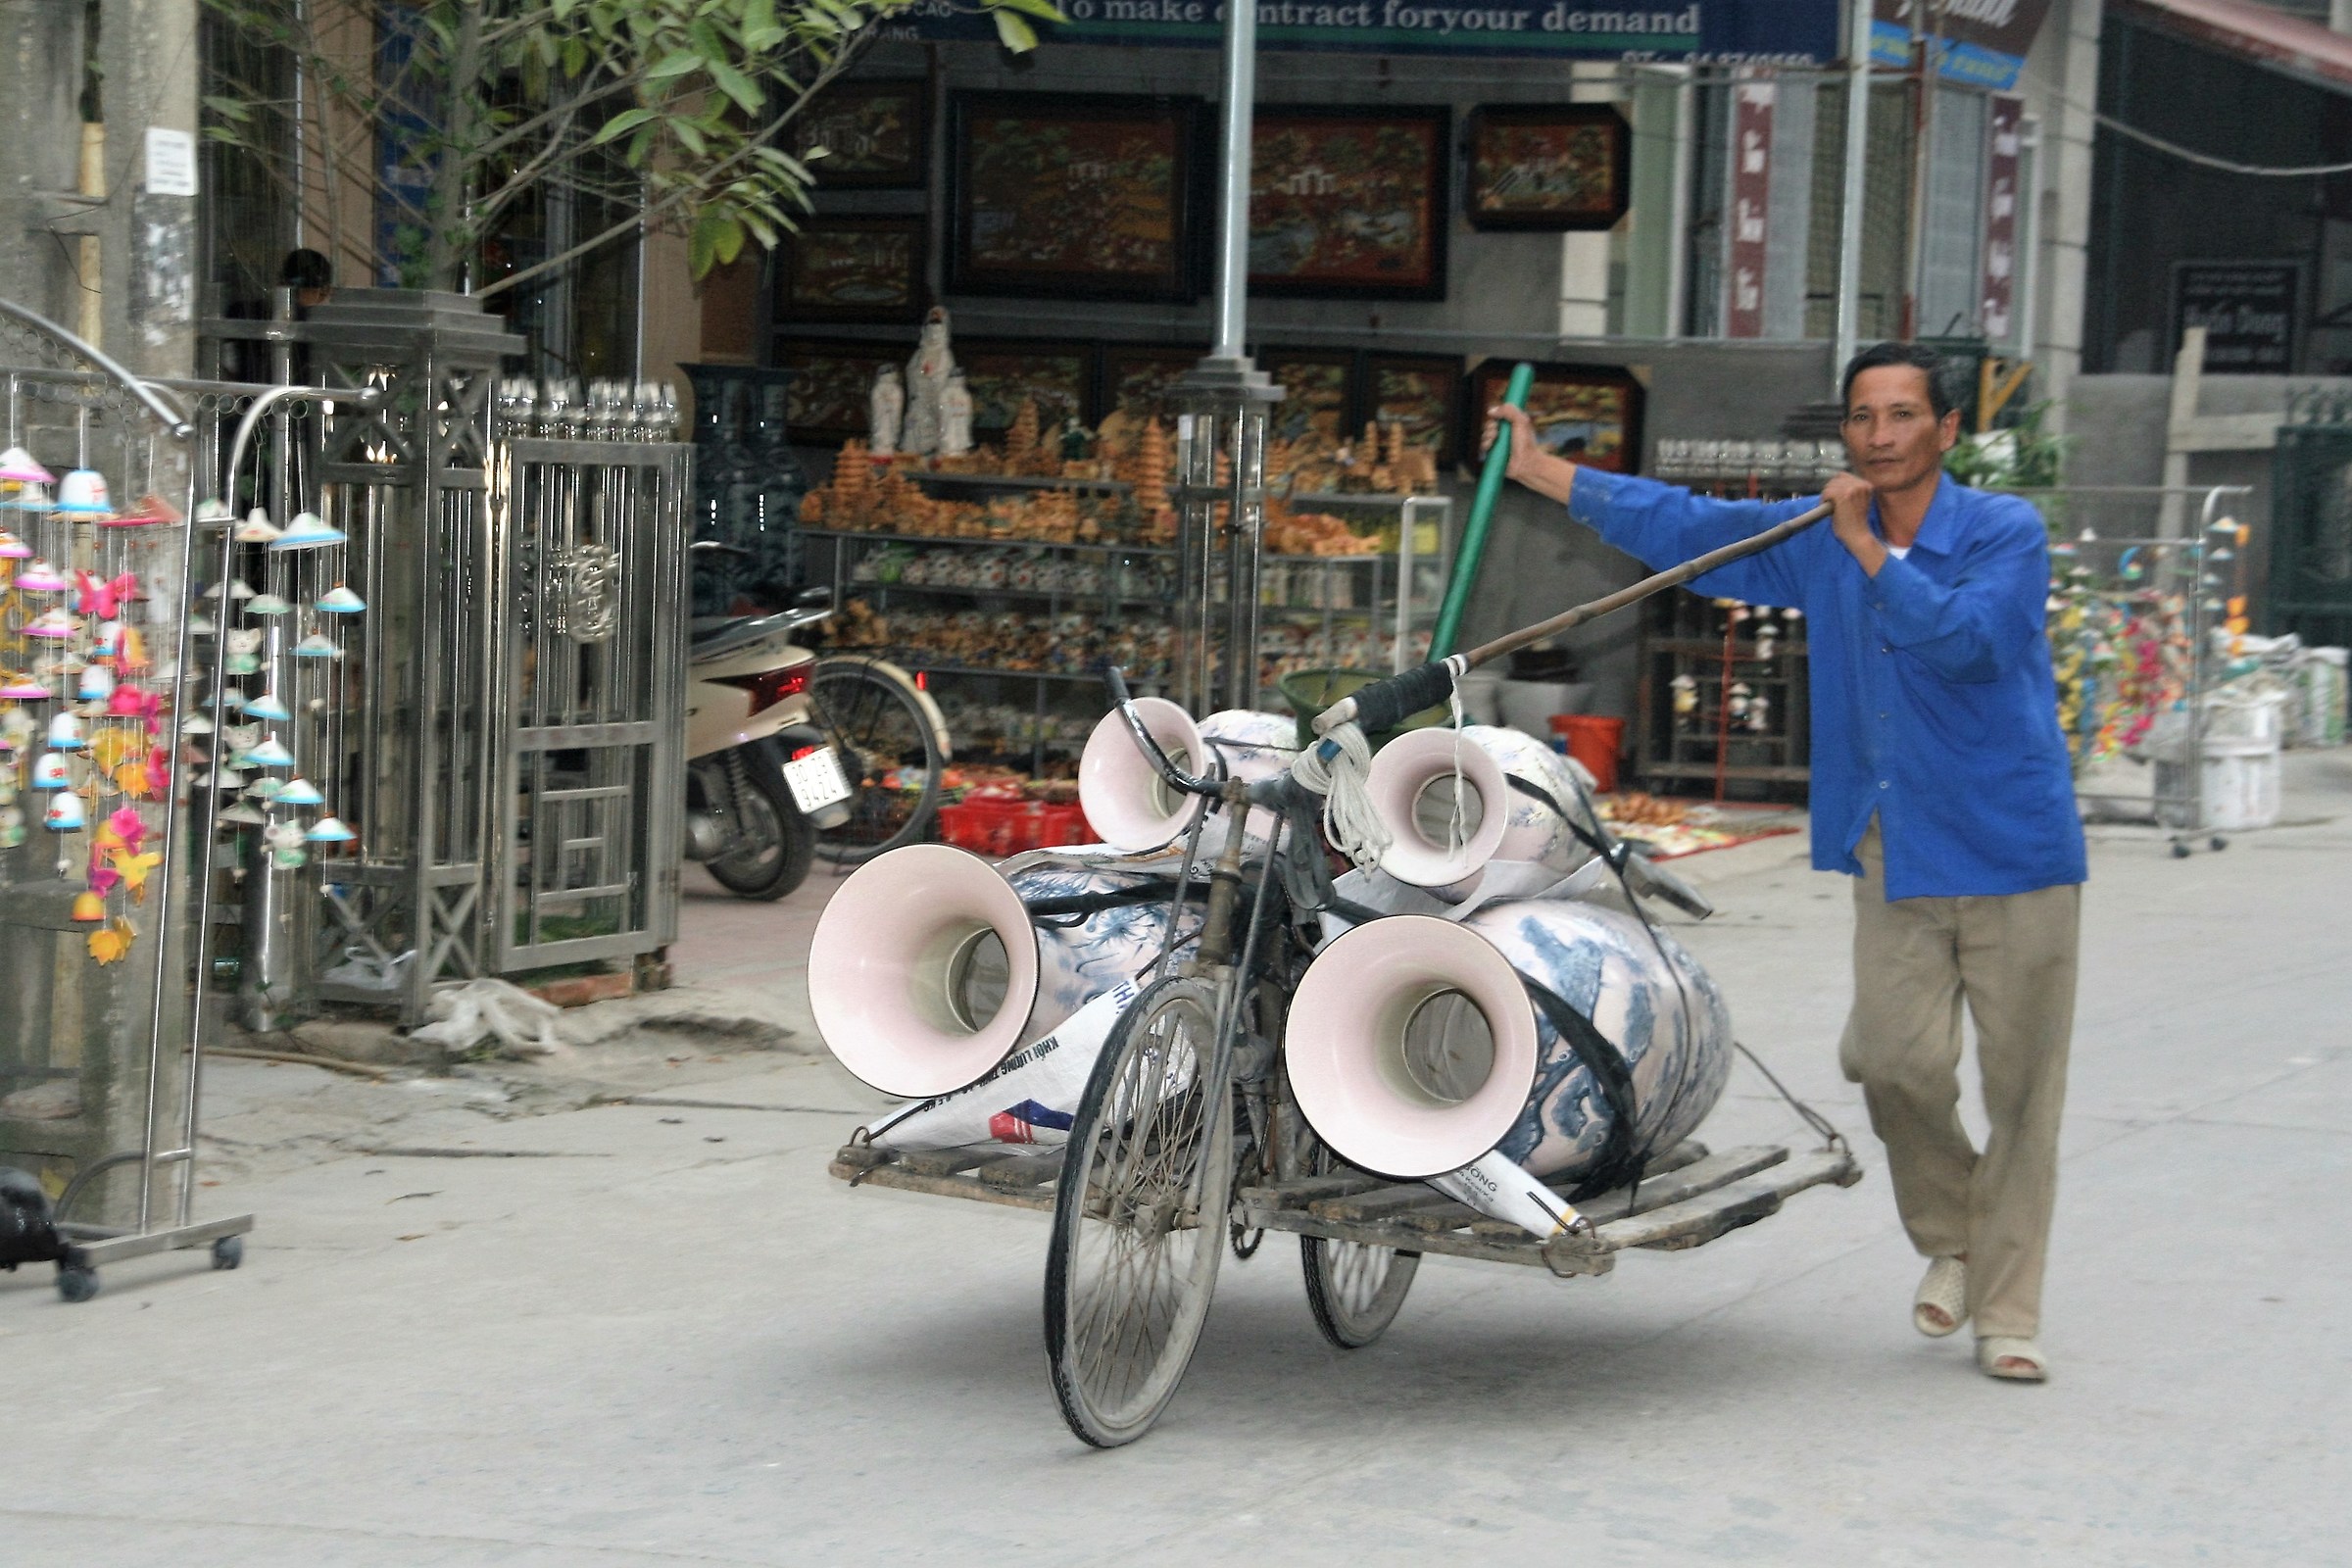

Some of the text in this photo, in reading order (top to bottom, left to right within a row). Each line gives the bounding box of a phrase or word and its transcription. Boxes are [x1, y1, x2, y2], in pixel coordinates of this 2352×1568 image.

[1104, 0, 1203, 22] make
[1214, 2, 1372, 26] cntract
[1541, 2, 1700, 33] demand
